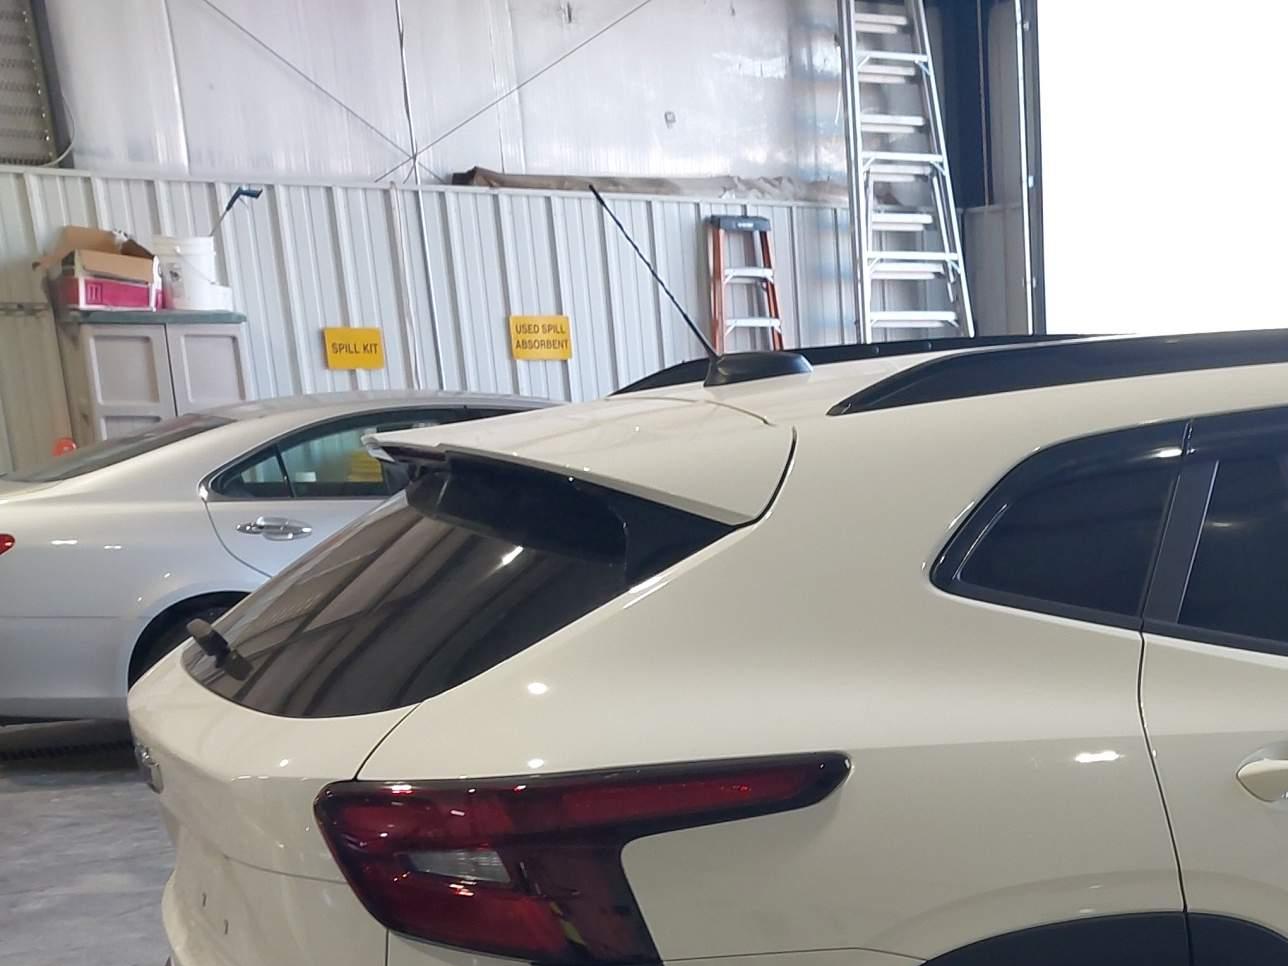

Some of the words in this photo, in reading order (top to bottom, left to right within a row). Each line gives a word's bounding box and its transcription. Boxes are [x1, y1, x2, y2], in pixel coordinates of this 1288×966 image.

[515, 324, 540, 335] USED
[541, 324, 567, 335] SPILL
[331, 342, 361, 354] SPILL
[362, 343, 378, 354] KIT
[515, 339, 569, 350] ABSORBENT
